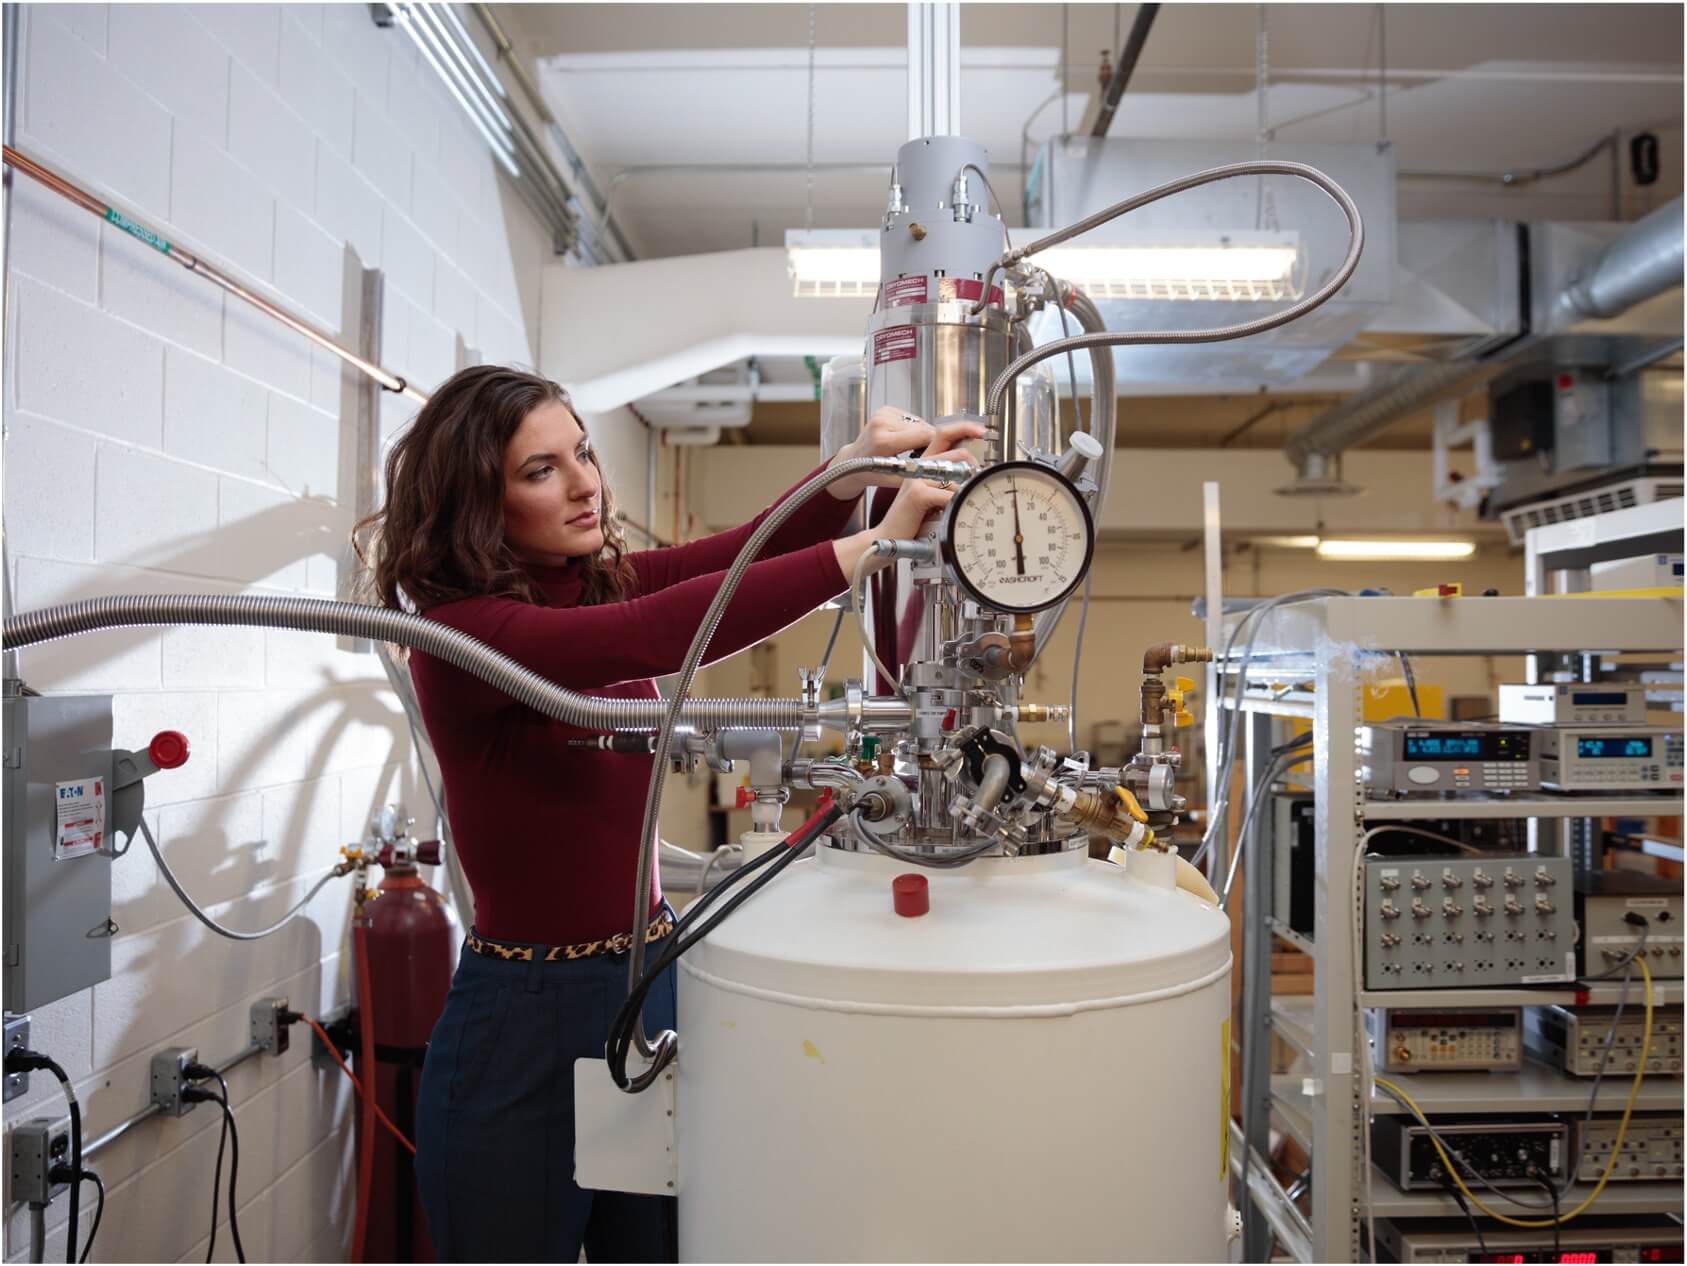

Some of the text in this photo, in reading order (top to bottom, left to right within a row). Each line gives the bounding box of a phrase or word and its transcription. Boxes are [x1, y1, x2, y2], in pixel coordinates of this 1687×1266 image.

[995, 559, 1007, 568] 100
[1003, 575, 1043, 583] ASHCROFT
[60, 785, 83, 798] EATON
